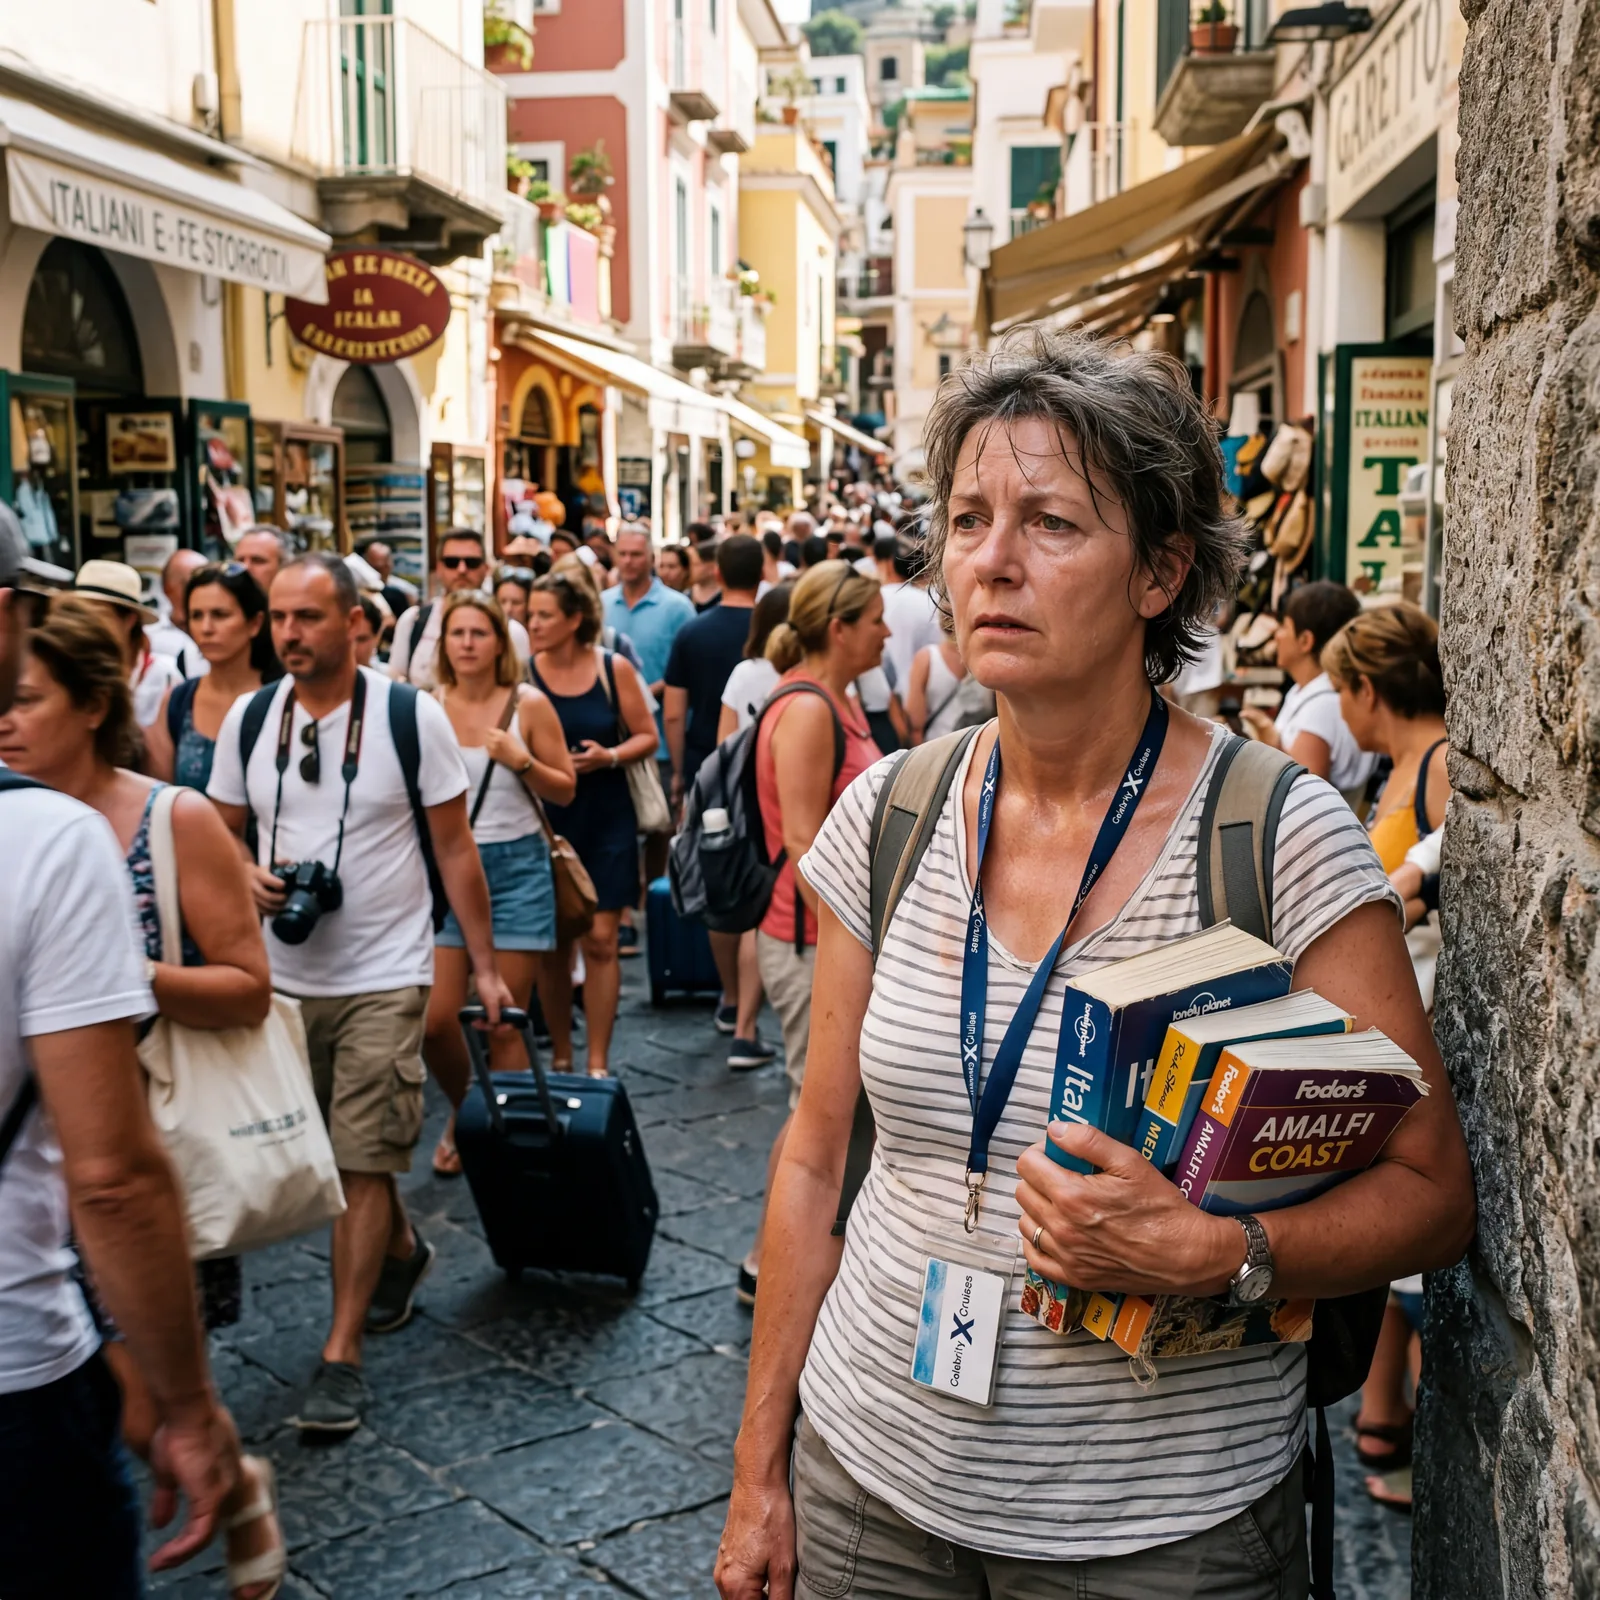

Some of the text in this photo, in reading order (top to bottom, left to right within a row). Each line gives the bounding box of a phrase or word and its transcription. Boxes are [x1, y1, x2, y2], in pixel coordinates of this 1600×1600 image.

[50, 178, 145, 246] ITALIANI
[1355, 408, 1429, 428] ITALIAN
[1172, 997, 1232, 1022] lonely planet
[1053, 1063, 1094, 1125] Ital
[1211, 1064, 1239, 1114] Fodor's
[1294, 1079, 1367, 1100] Fodor's
[1252, 1112, 1375, 1142] AMALFI
[1249, 1140, 1353, 1173] COAST
[950, 1312, 975, 1345] X
